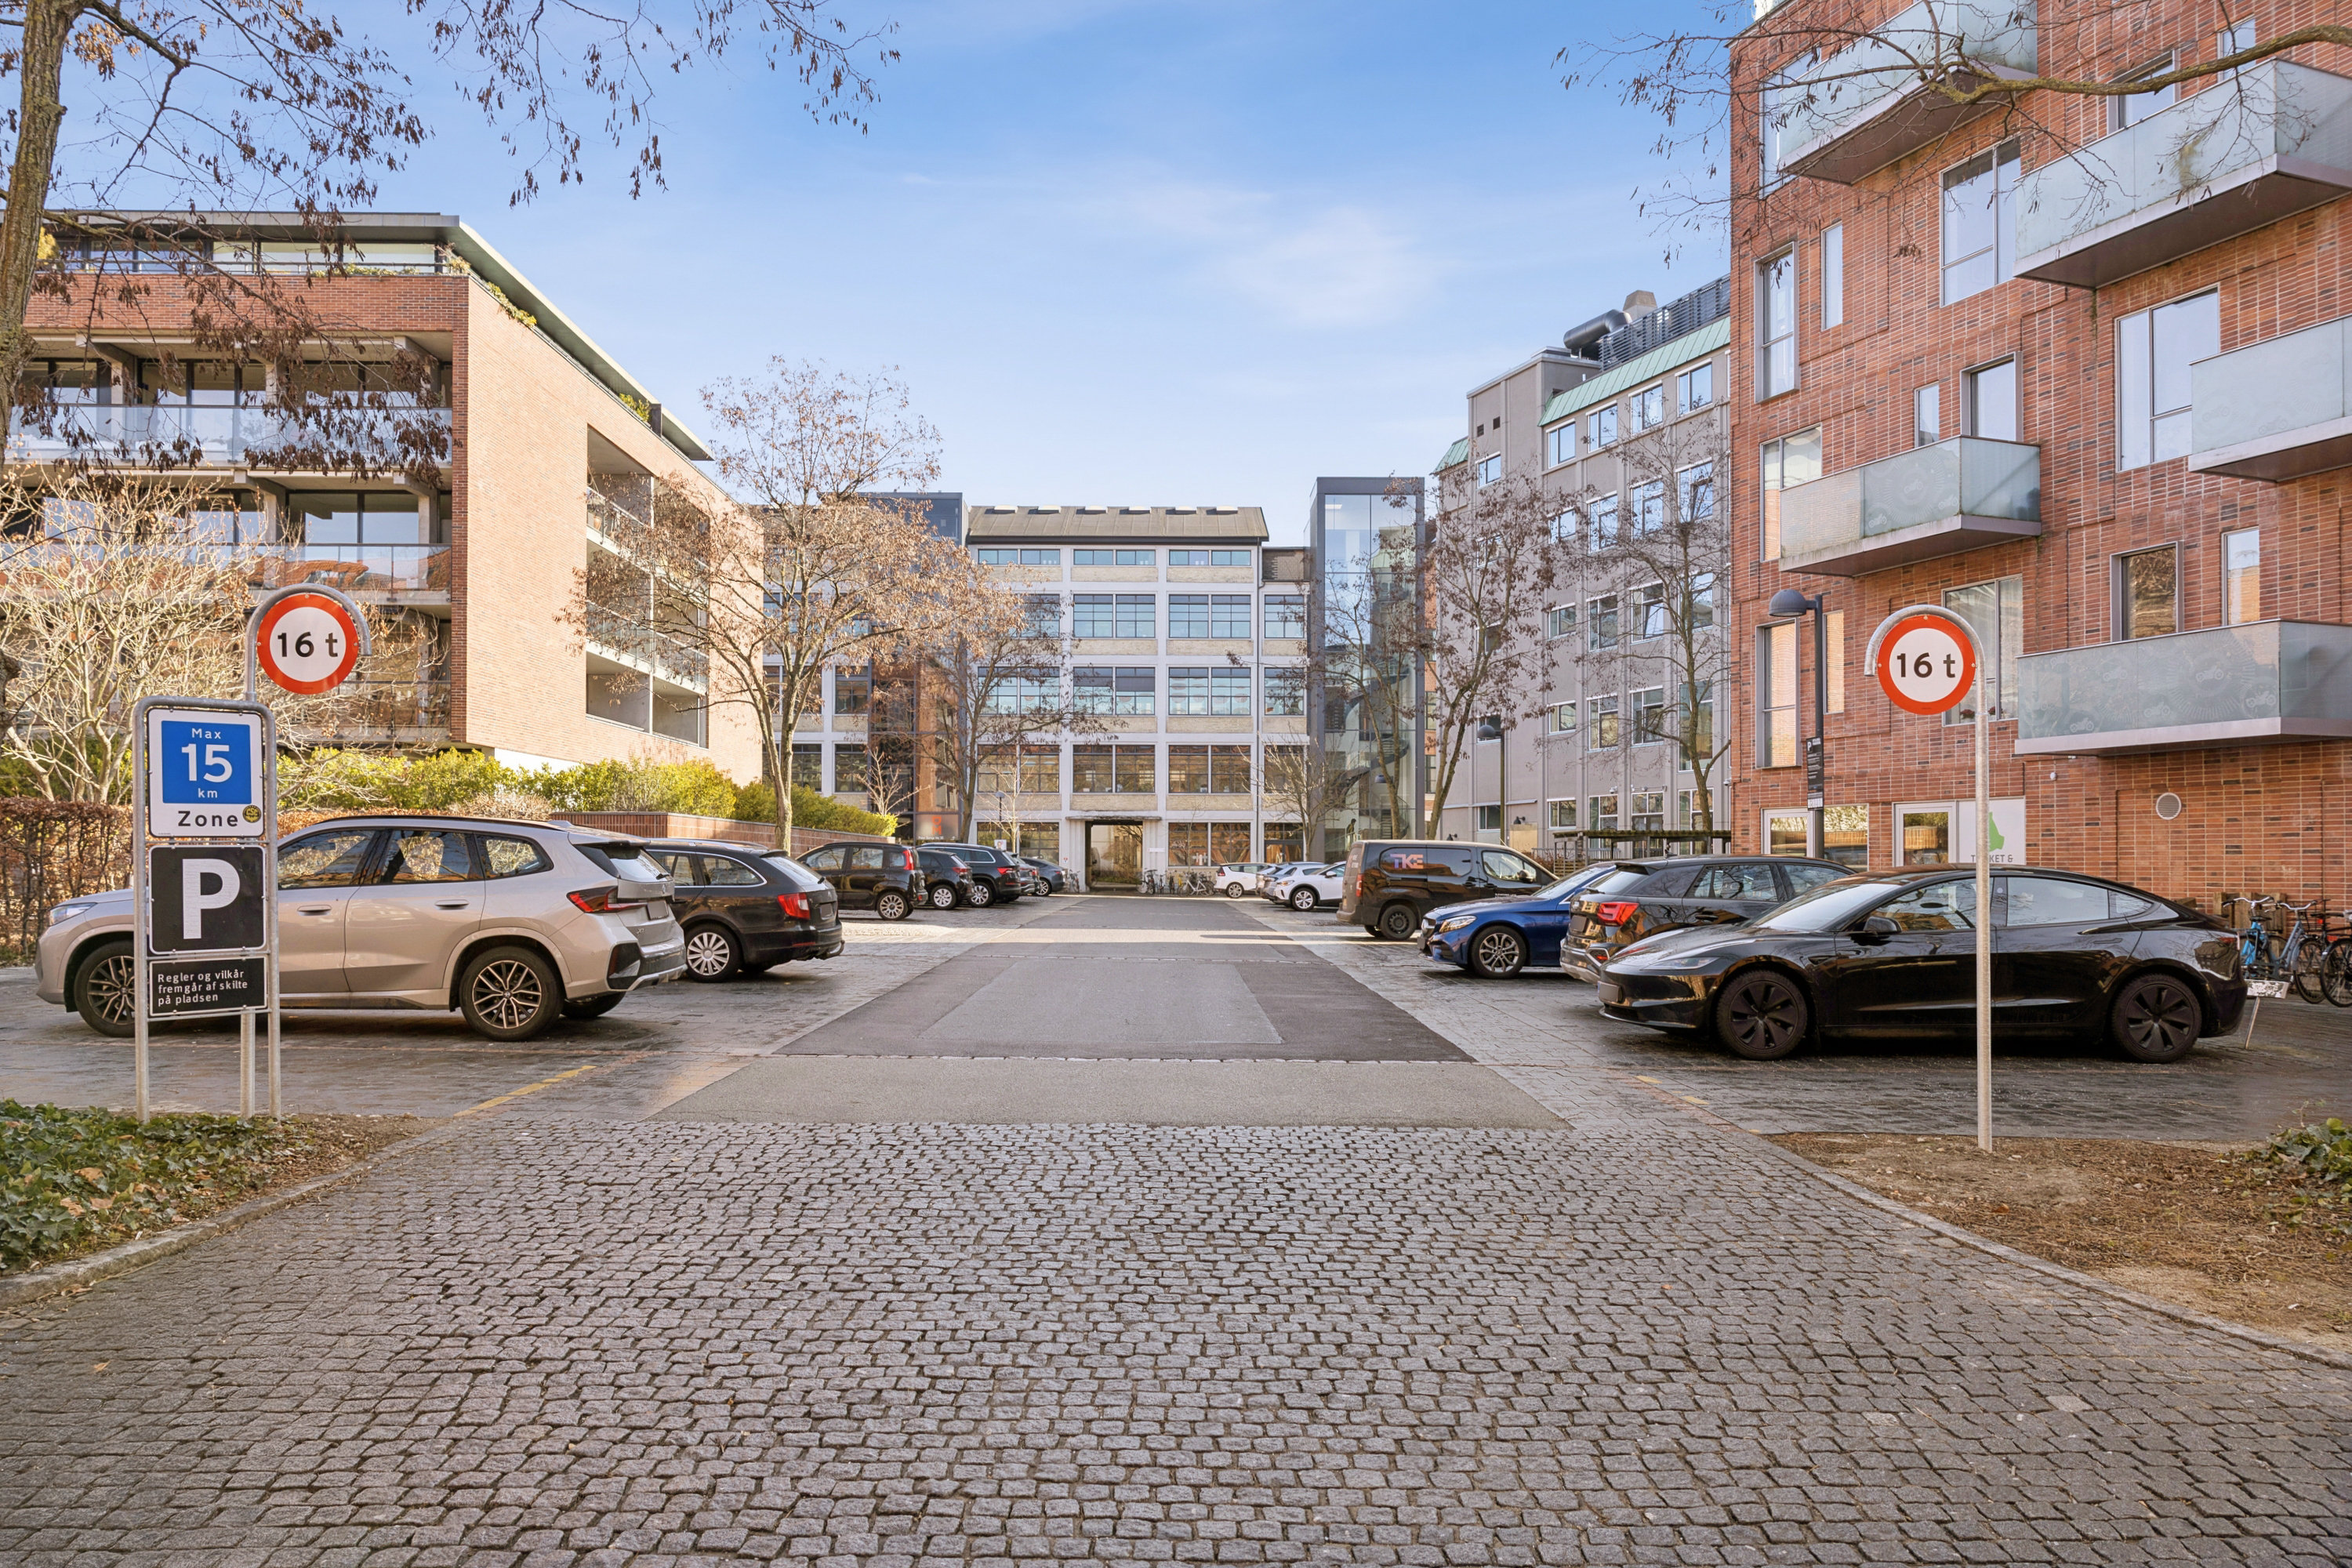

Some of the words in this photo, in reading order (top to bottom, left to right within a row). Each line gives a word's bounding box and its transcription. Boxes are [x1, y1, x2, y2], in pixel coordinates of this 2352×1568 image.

[278, 631, 314, 658] 16
[325, 632, 338, 657] t
[1896, 652, 1933, 678] 16
[1943, 653, 1955, 678] t
[191, 728, 222, 739] Max
[181, 743, 233, 783] 15
[198, 788, 218, 798] km
[178, 811, 238, 827] Zone
[1390, 853, 1425, 869] TKE
[2007, 854, 2013, 863] &
[182, 858, 241, 940] P
[158, 972, 194, 984] Regler
[198, 973, 211, 982] og
[215, 969, 244, 979] vilkår
[158, 982, 202, 994] fremgår
[205, 981, 216, 991] af
[220, 980, 248, 990] skilte
[158, 995, 171, 1007] på
[176, 993, 218, 1006] pladsen
